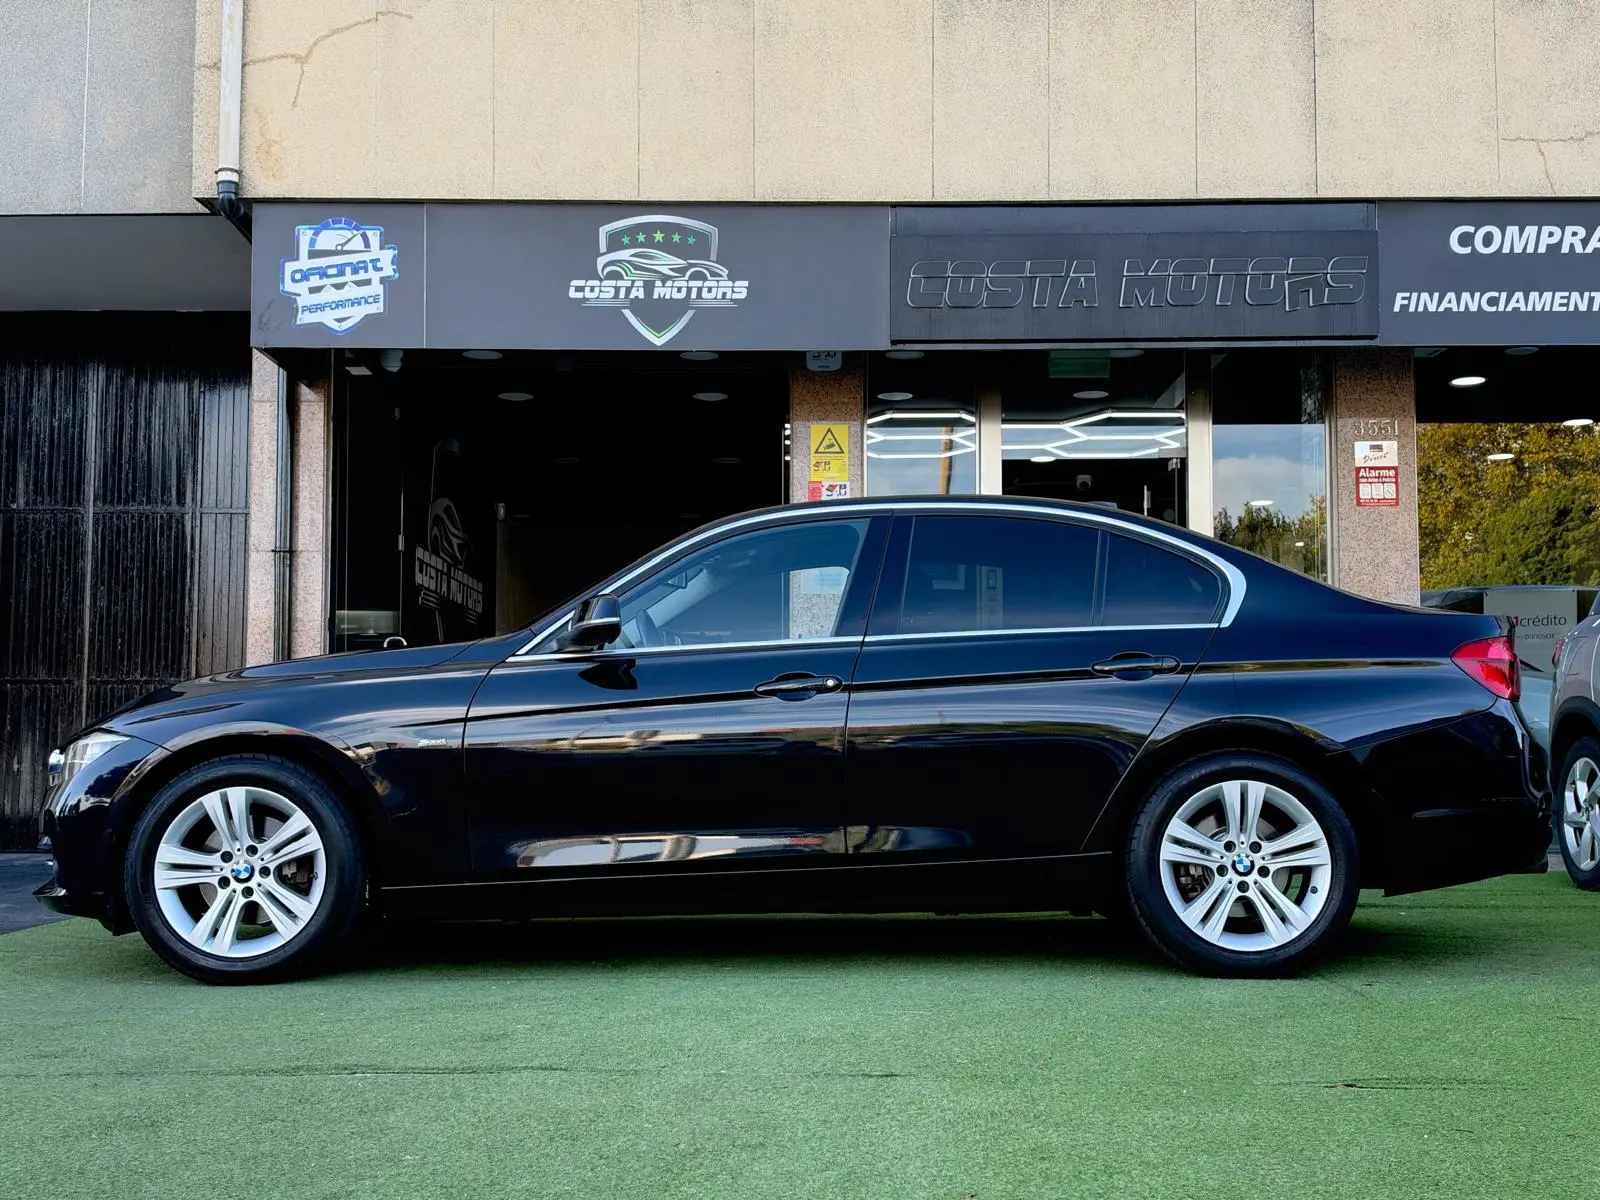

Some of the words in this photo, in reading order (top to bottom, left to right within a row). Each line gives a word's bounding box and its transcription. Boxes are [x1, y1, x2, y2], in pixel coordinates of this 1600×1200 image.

[568, 279, 645, 299] COSTA
[652, 279, 750, 300] MOTORS
[906, 259, 1099, 309] COSTA
[1118, 255, 1369, 312] MOTORS
[301, 294, 381, 315] PERFORMANCE
[1354, 419, 1399, 436] 3551
[1358, 467, 1396, 478] Alarme
